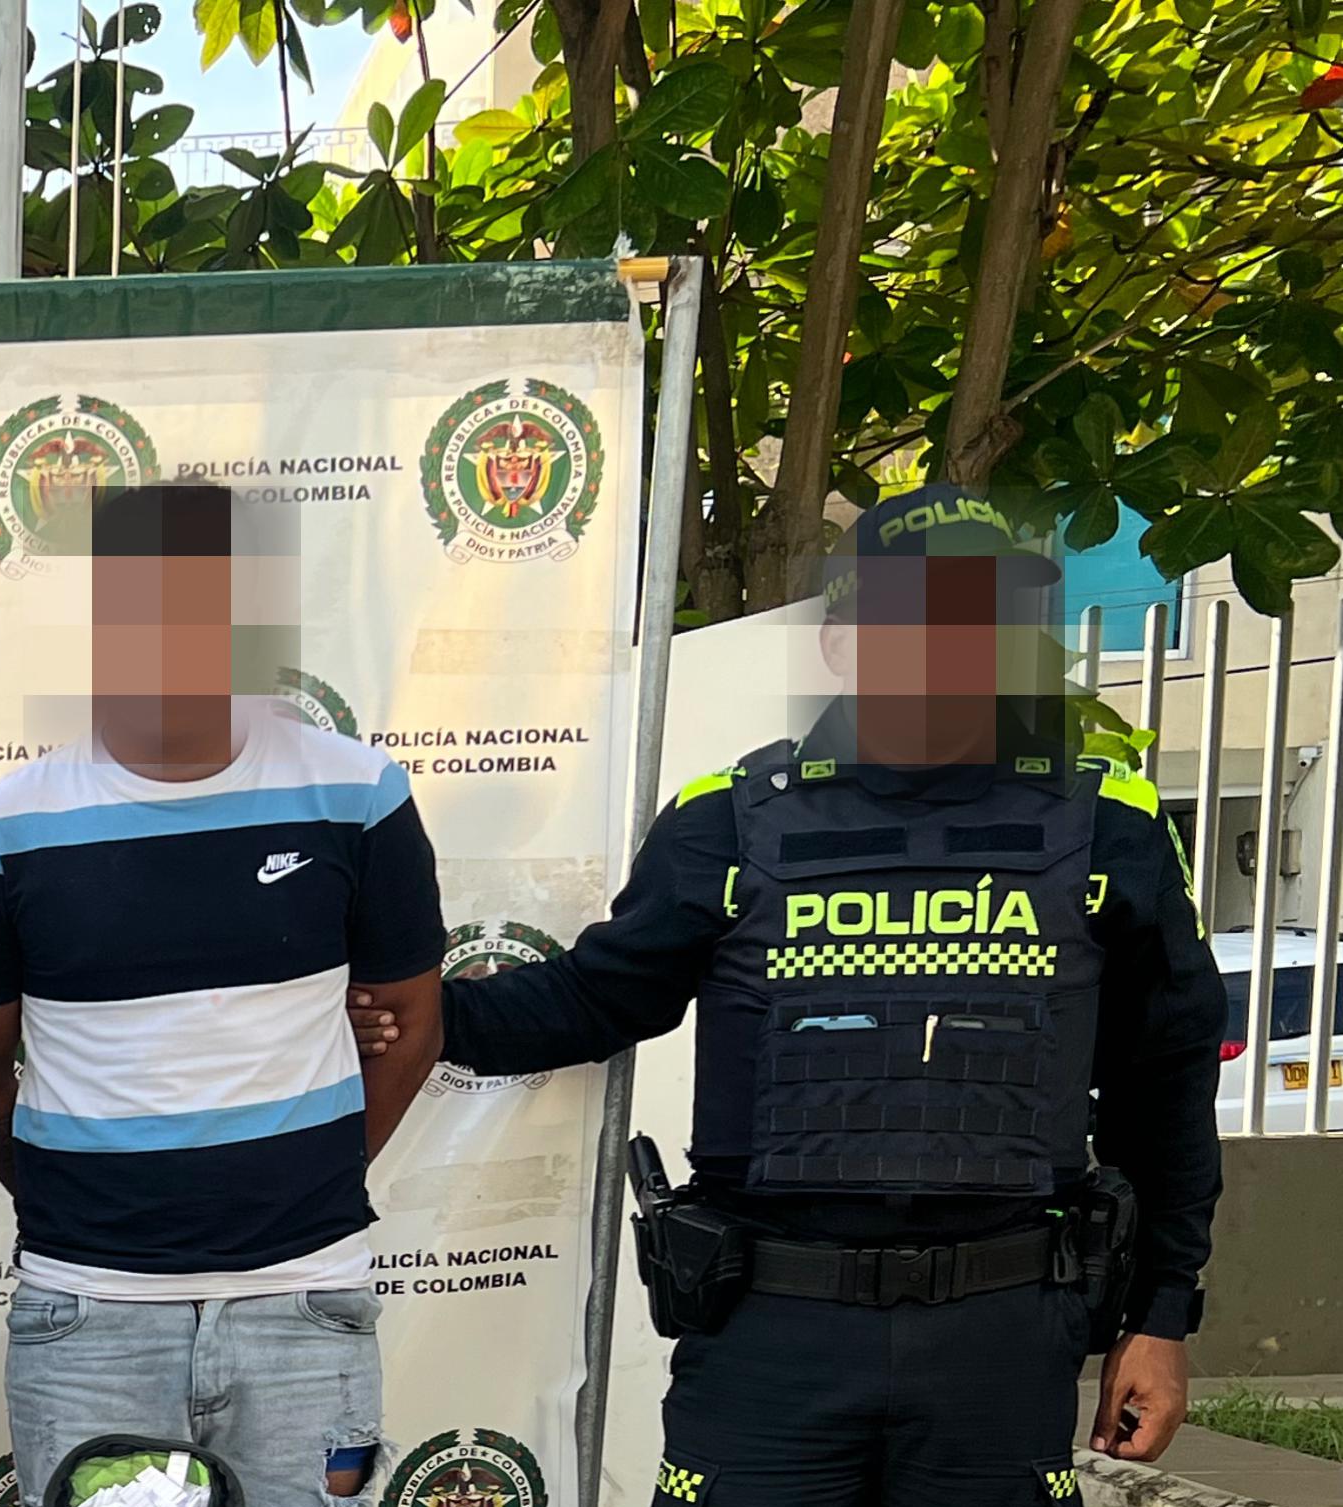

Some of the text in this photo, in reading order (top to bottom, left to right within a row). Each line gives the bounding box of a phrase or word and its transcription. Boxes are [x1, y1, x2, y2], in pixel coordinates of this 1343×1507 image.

[62, 415, 81, 425] DE
[95, 422, 139, 487] COLOMBI
[509, 399, 529, 410] DE
[542, 407, 583, 480] COLOMBIA
[177, 455, 404, 478] POLICÍA NACIONAL
[244, 484, 371, 504] COLOMBIA
[509, 495, 575, 541] NACIONAL
[508, 536, 558, 559] PATRIA
[370, 727, 590, 747] POLICÍA NACIONAL
[432, 756, 557, 774] COLOMBIA
[265, 851, 301, 872] NIKE
[785, 873, 1040, 939] POLICÍA
[484, 940, 504, 950] DE
[370, 1244, 559, 1270] LICÍA NACIONAL
[375, 1271, 528, 1295] DE COLOMBIA
[459, 1447, 478, 1457] DE
